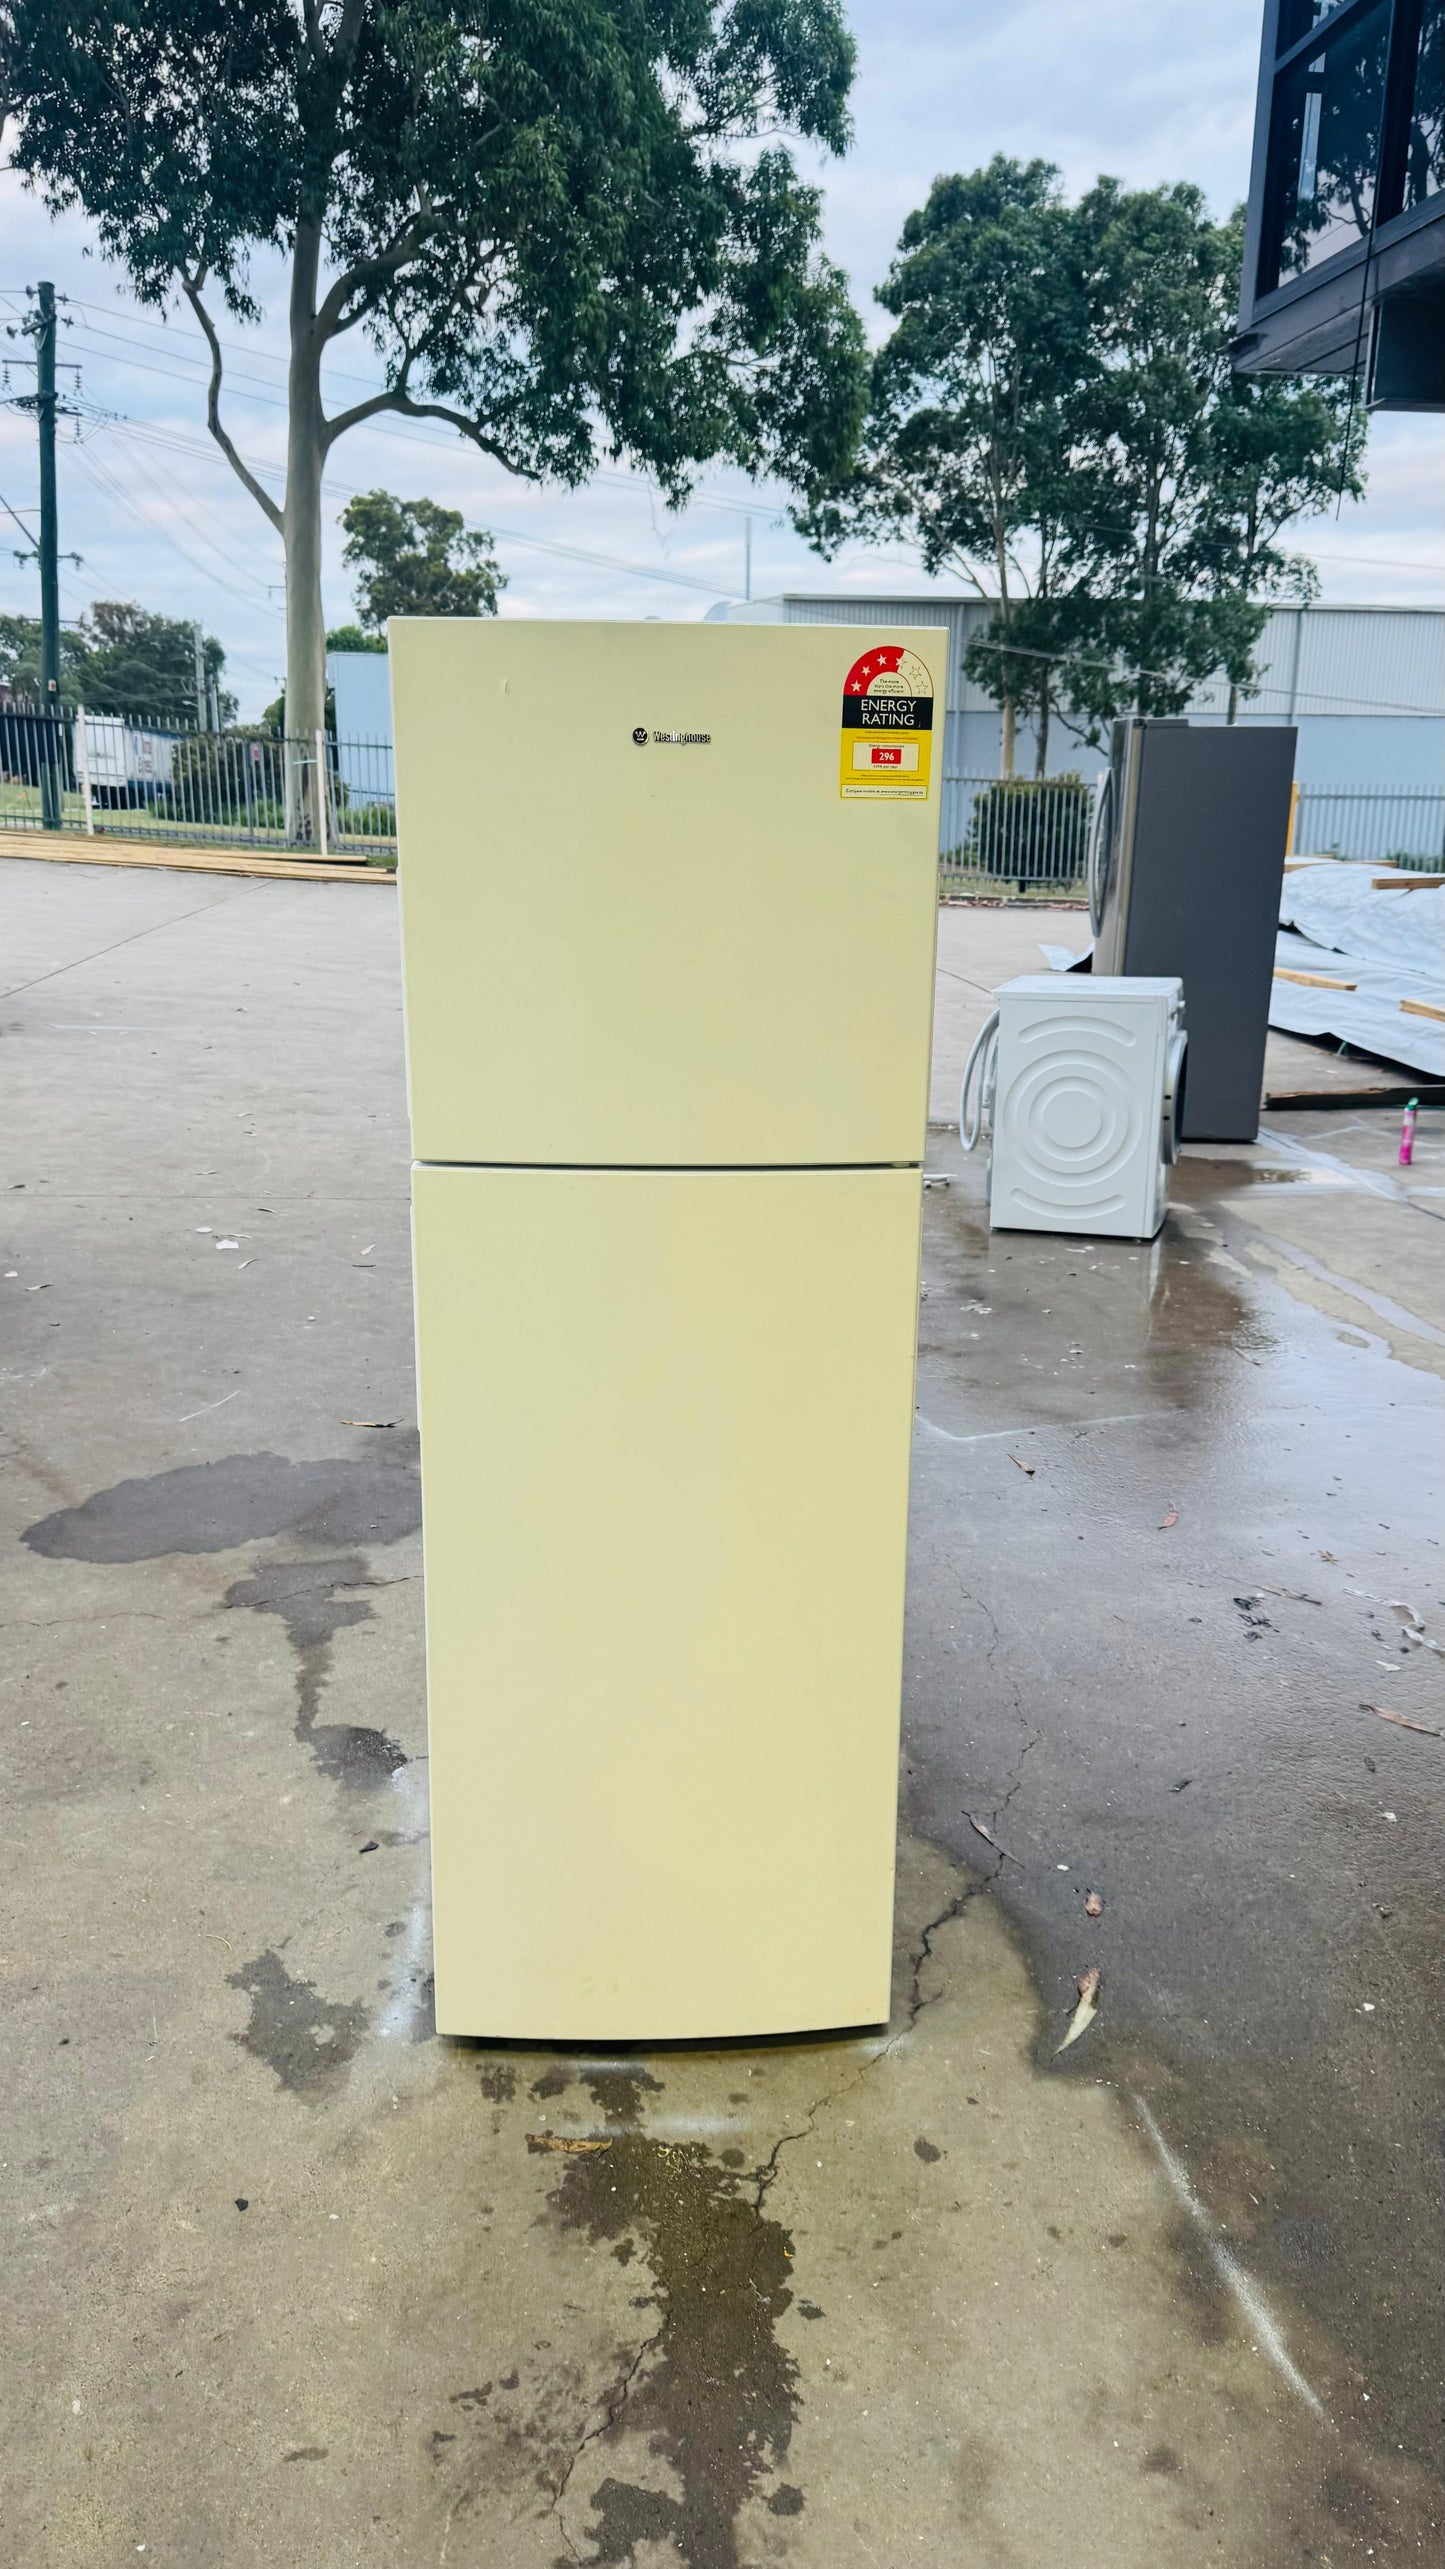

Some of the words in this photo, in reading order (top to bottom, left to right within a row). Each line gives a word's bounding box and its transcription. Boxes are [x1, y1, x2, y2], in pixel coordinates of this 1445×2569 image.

[861, 699, 917, 712] ENERGY
[862, 713, 915, 725] RATING
[879, 752, 895, 761] 296
